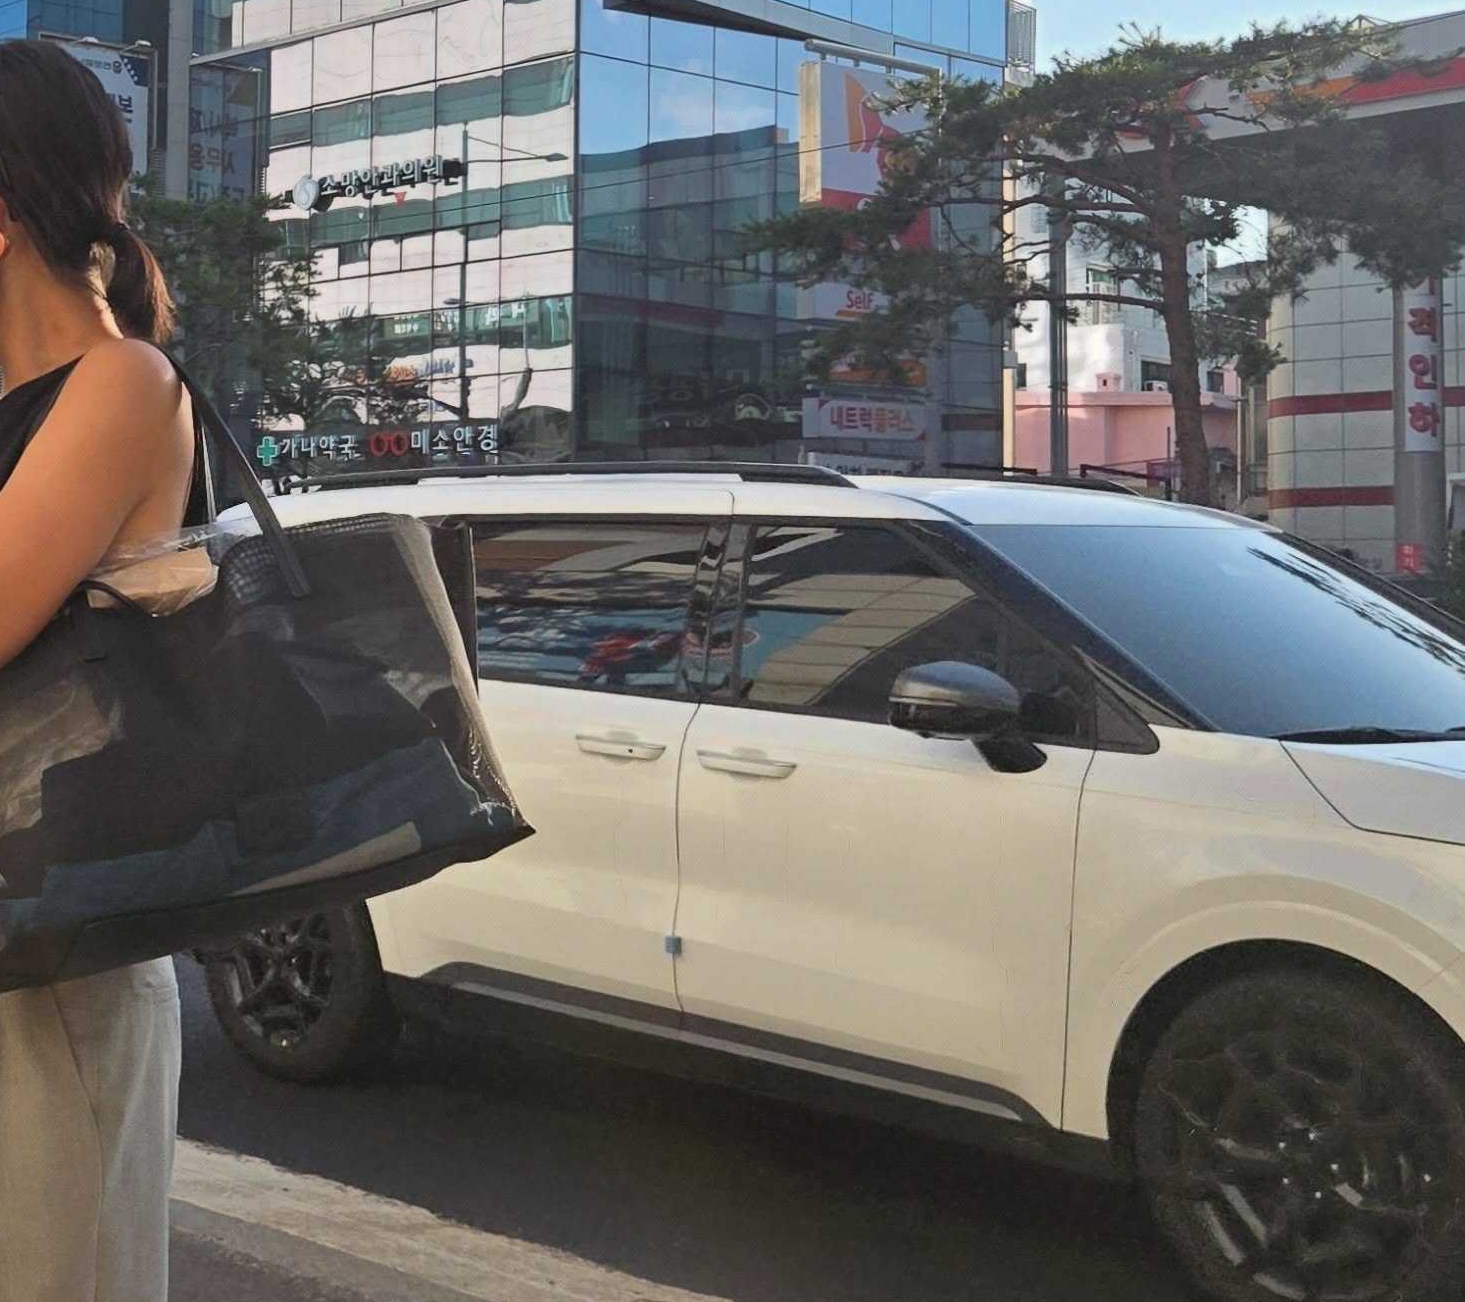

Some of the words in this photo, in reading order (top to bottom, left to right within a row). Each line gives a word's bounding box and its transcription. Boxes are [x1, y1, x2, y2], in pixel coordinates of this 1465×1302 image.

[320, 154, 443, 197] 소망안과의원
[845, 289, 875, 310] Self
[829, 405, 916, 433] 내트럭플러스
[281, 434, 357, 462] 가나약국
[411, 424, 499, 455] 미소안경
